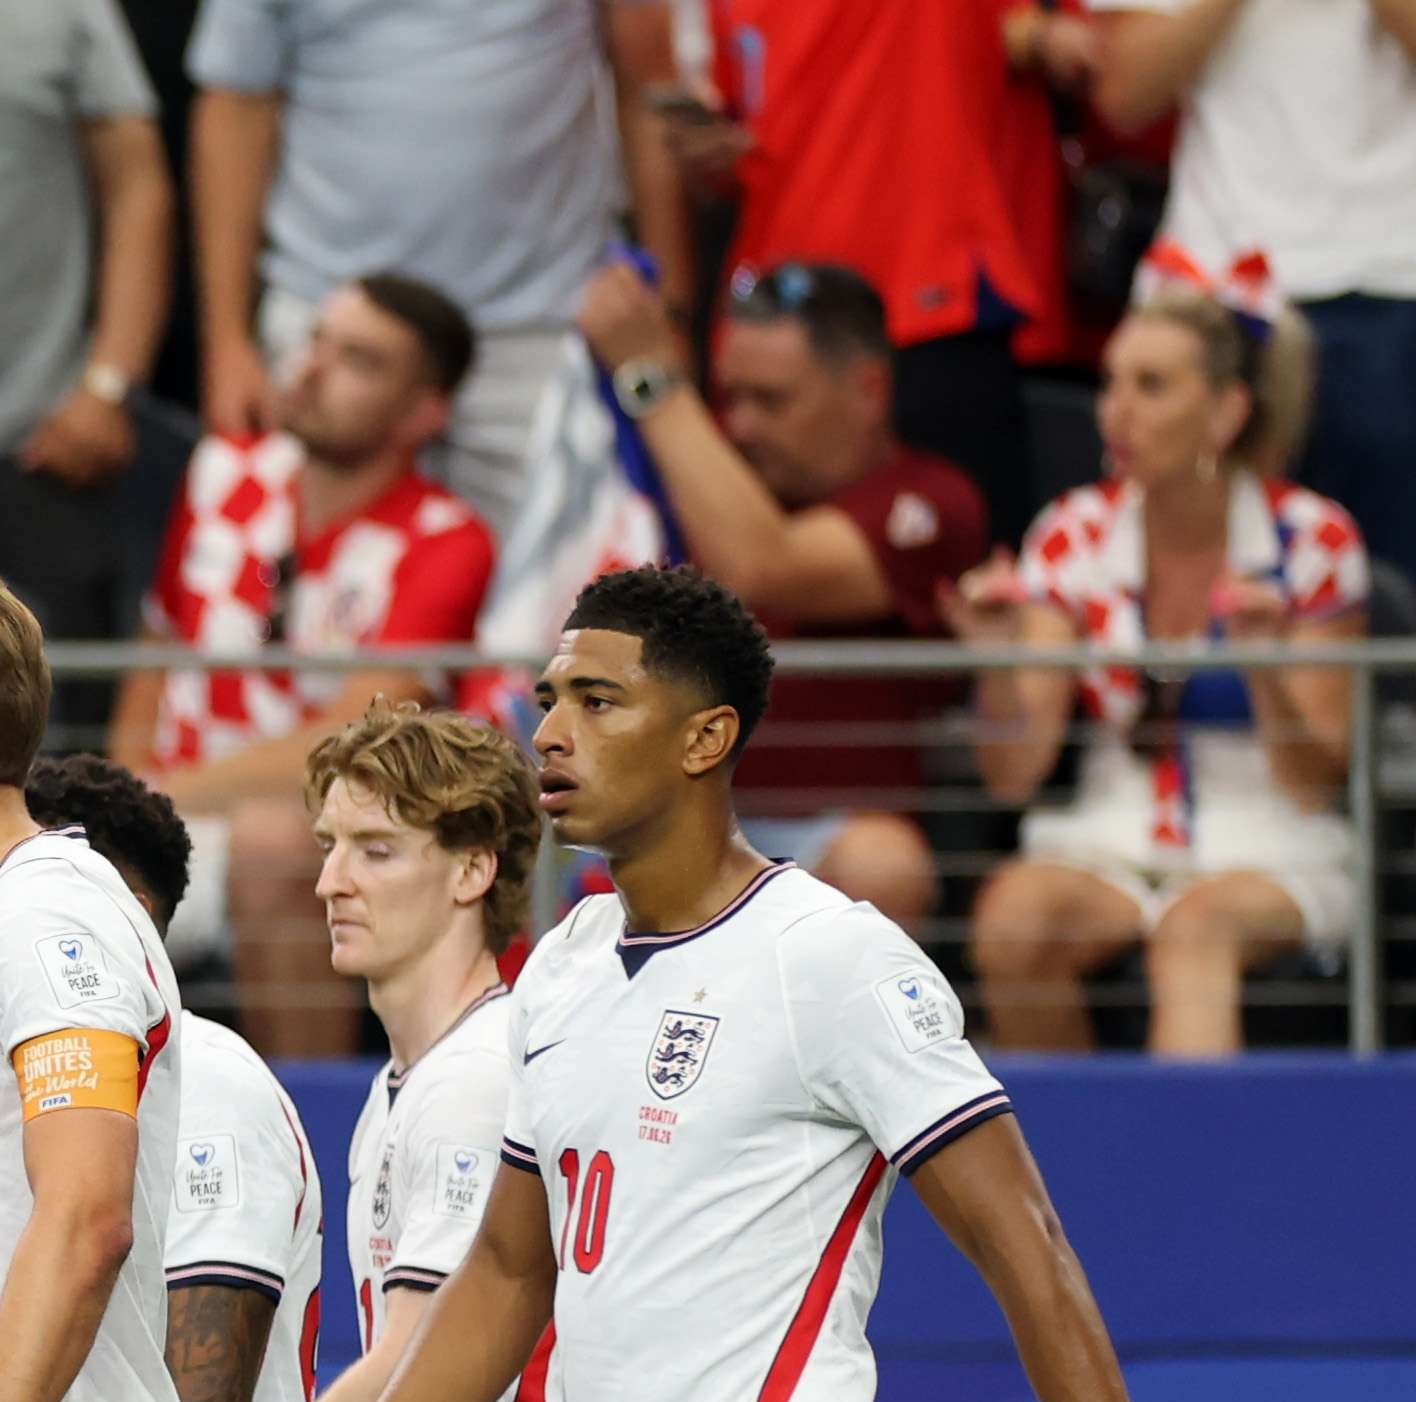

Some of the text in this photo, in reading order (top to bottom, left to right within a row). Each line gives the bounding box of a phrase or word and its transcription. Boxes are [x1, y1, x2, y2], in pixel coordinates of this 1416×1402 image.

[68, 973, 101, 991] PEACE
[913, 1012, 944, 1033] PEACE
[23, 1037, 92, 1061] FOOTBALL
[24, 1051, 94, 1083] UNITES
[45, 1071, 99, 1093] World
[42, 1096, 68, 1108] FIFA
[638, 1106, 678, 1125] CROATIA
[638, 1125, 672, 1145] 17.06.26
[190, 1182, 222, 1198] PEACE
[558, 1147, 615, 1275] 10
